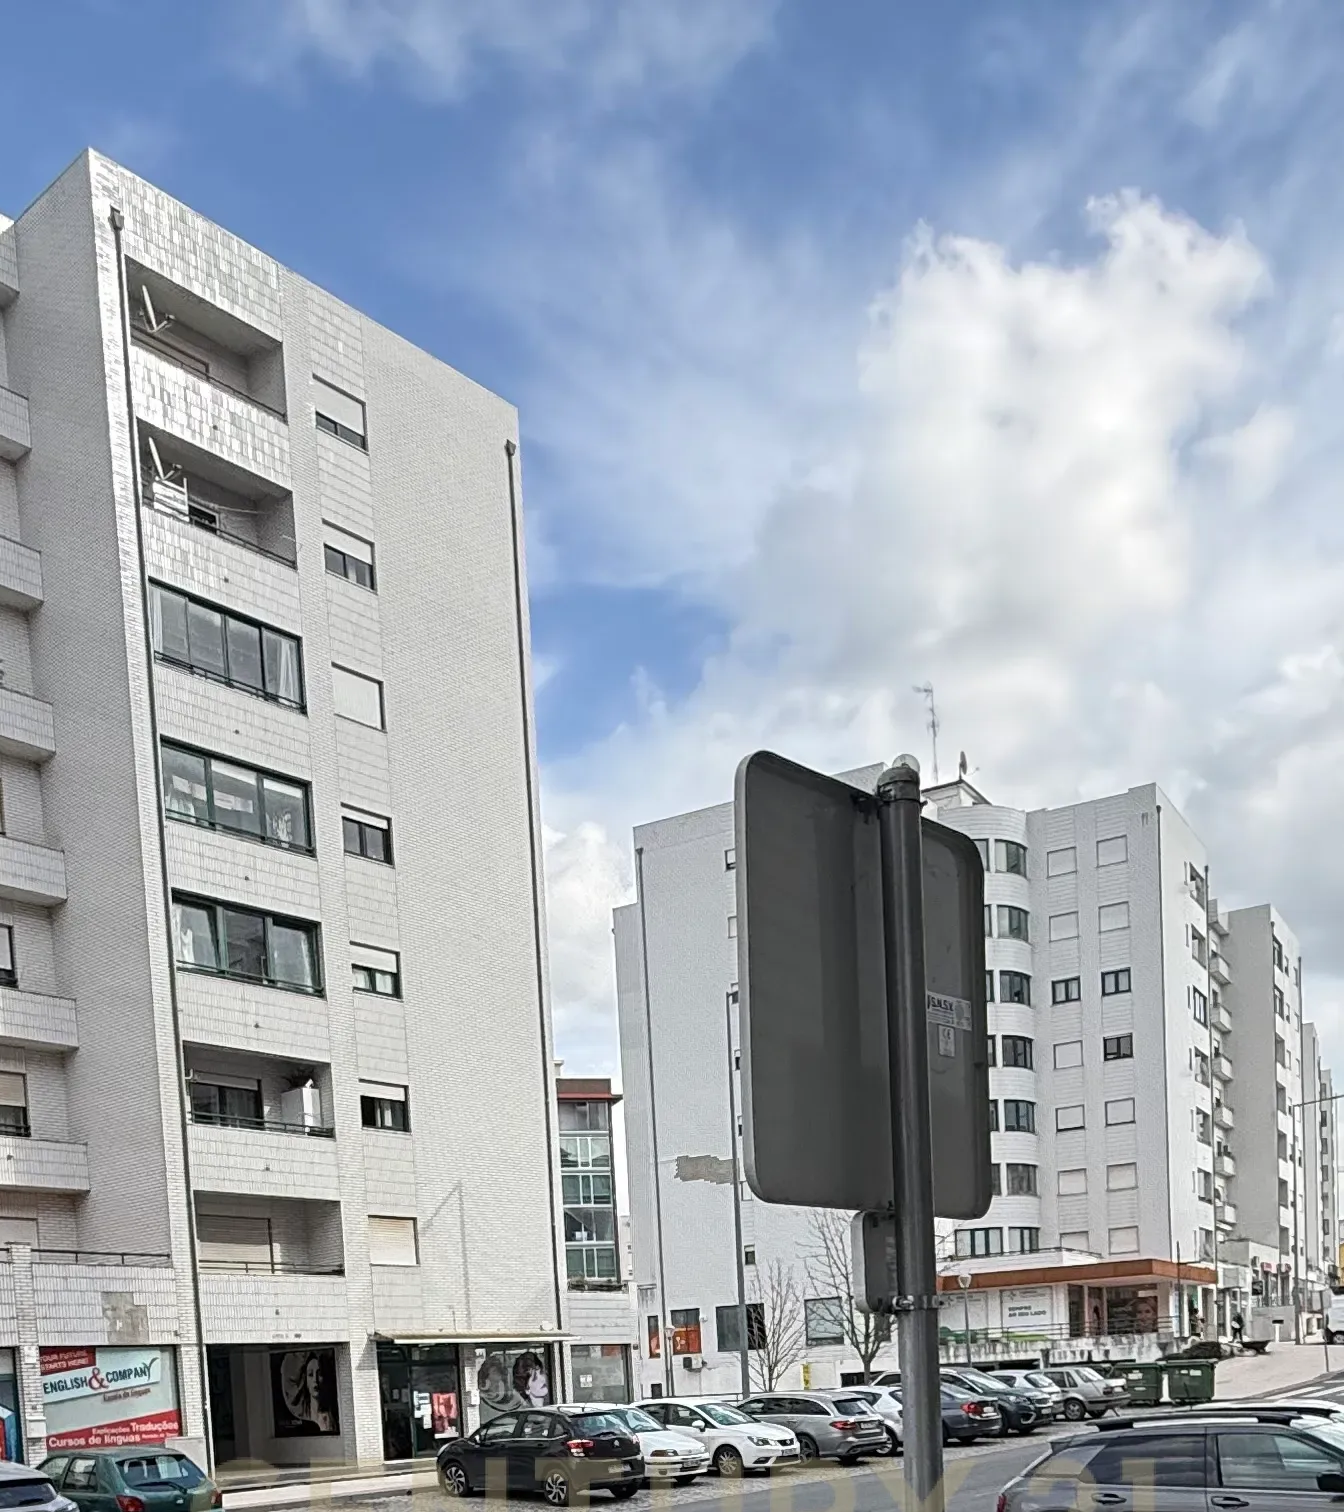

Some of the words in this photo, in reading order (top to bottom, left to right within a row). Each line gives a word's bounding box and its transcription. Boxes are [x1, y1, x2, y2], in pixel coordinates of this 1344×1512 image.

[43, 1376, 88, 1394] ENGLISH
[88, 1367, 109, 1391] &
[106, 1357, 159, 1384] COMPANY
[130, 1421, 179, 1432] Traduções
[49, 1434, 86, 1448] Cursos
[88, 1435, 102, 1445] de
[104, 1433, 141, 1445] línguas
